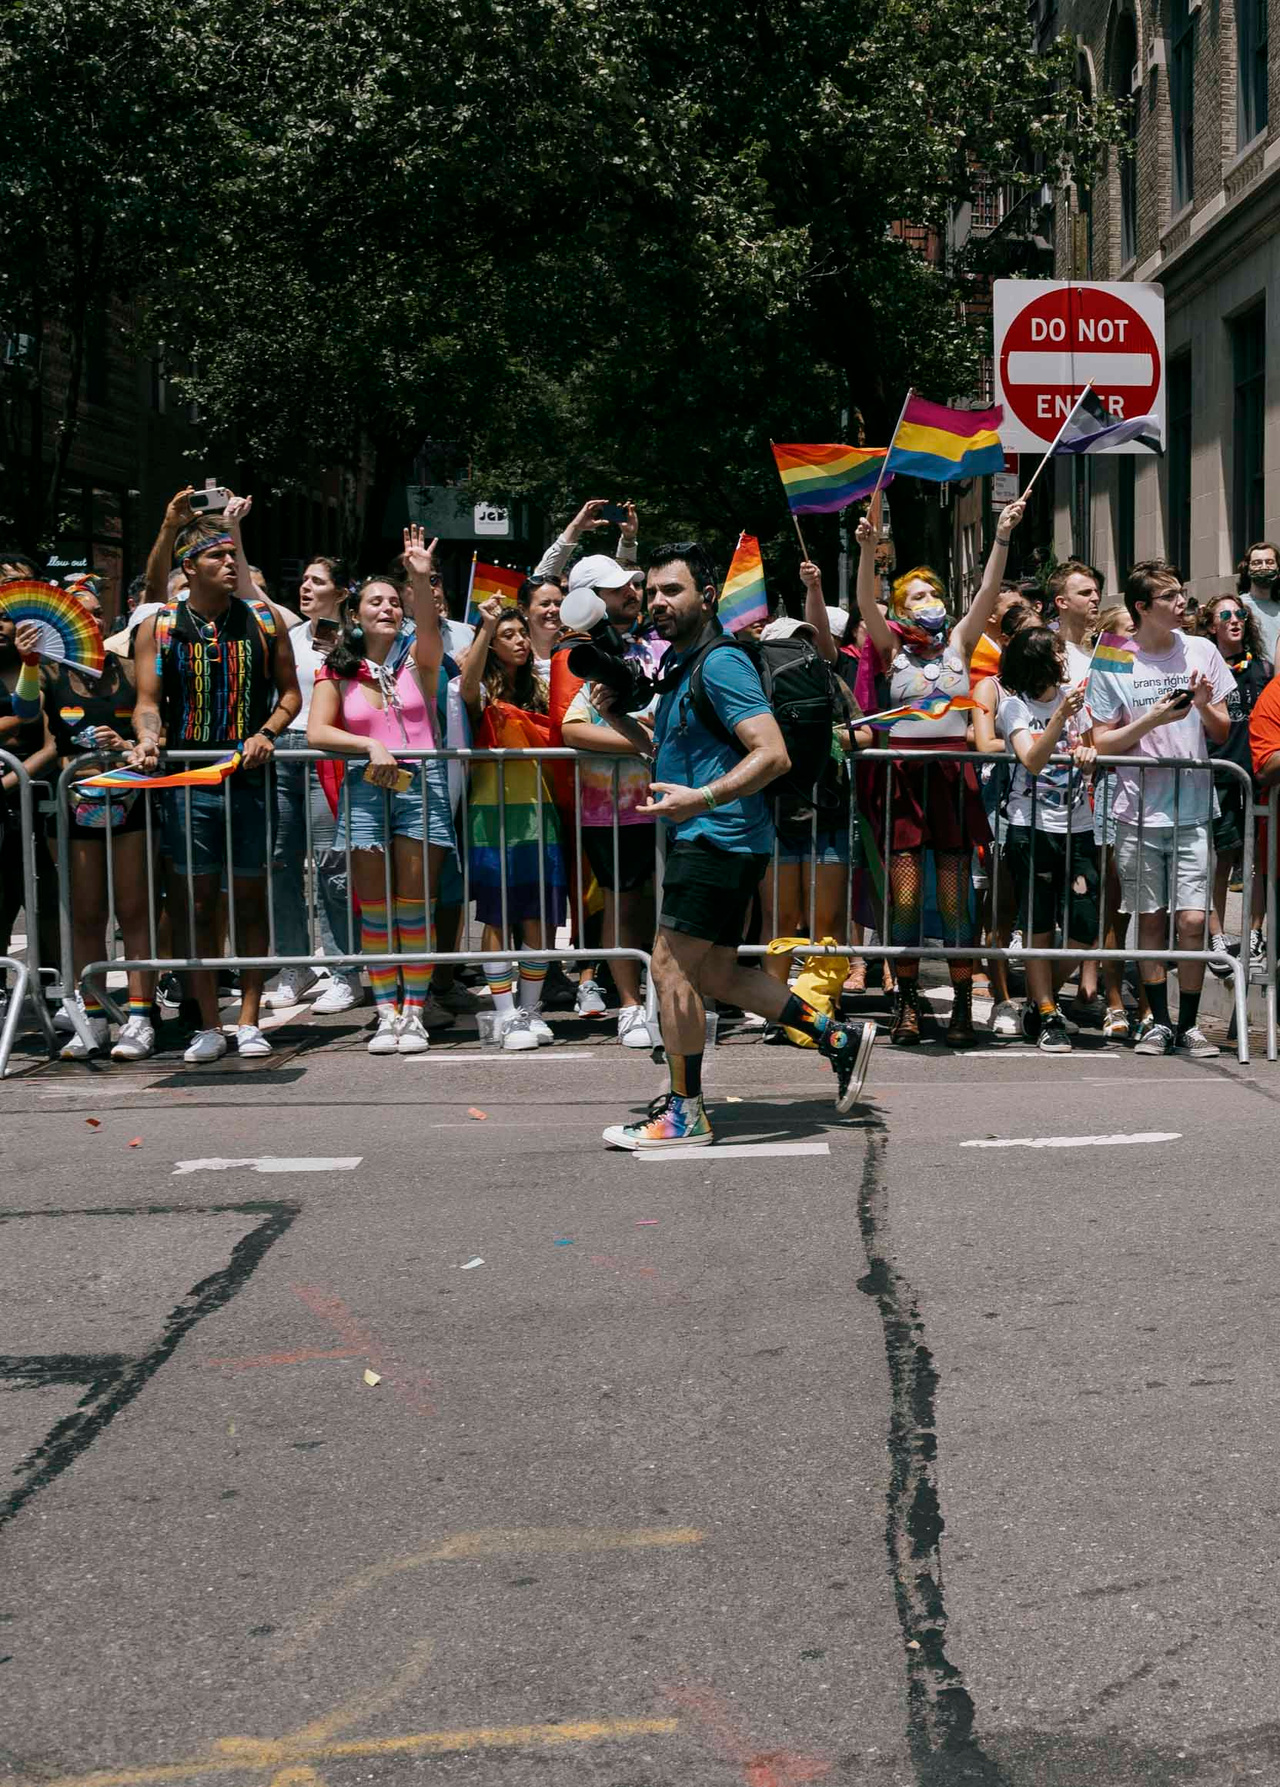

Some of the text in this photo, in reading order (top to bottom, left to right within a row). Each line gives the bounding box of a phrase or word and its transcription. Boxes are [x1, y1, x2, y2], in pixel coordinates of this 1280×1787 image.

[1031, 317, 1129, 343] DO NOT
[1037, 394, 1125, 419] ENR
[1133, 675, 1191, 689] trans right
[1157, 687, 1174, 695] are
[1132, 696, 1160, 707] huma
